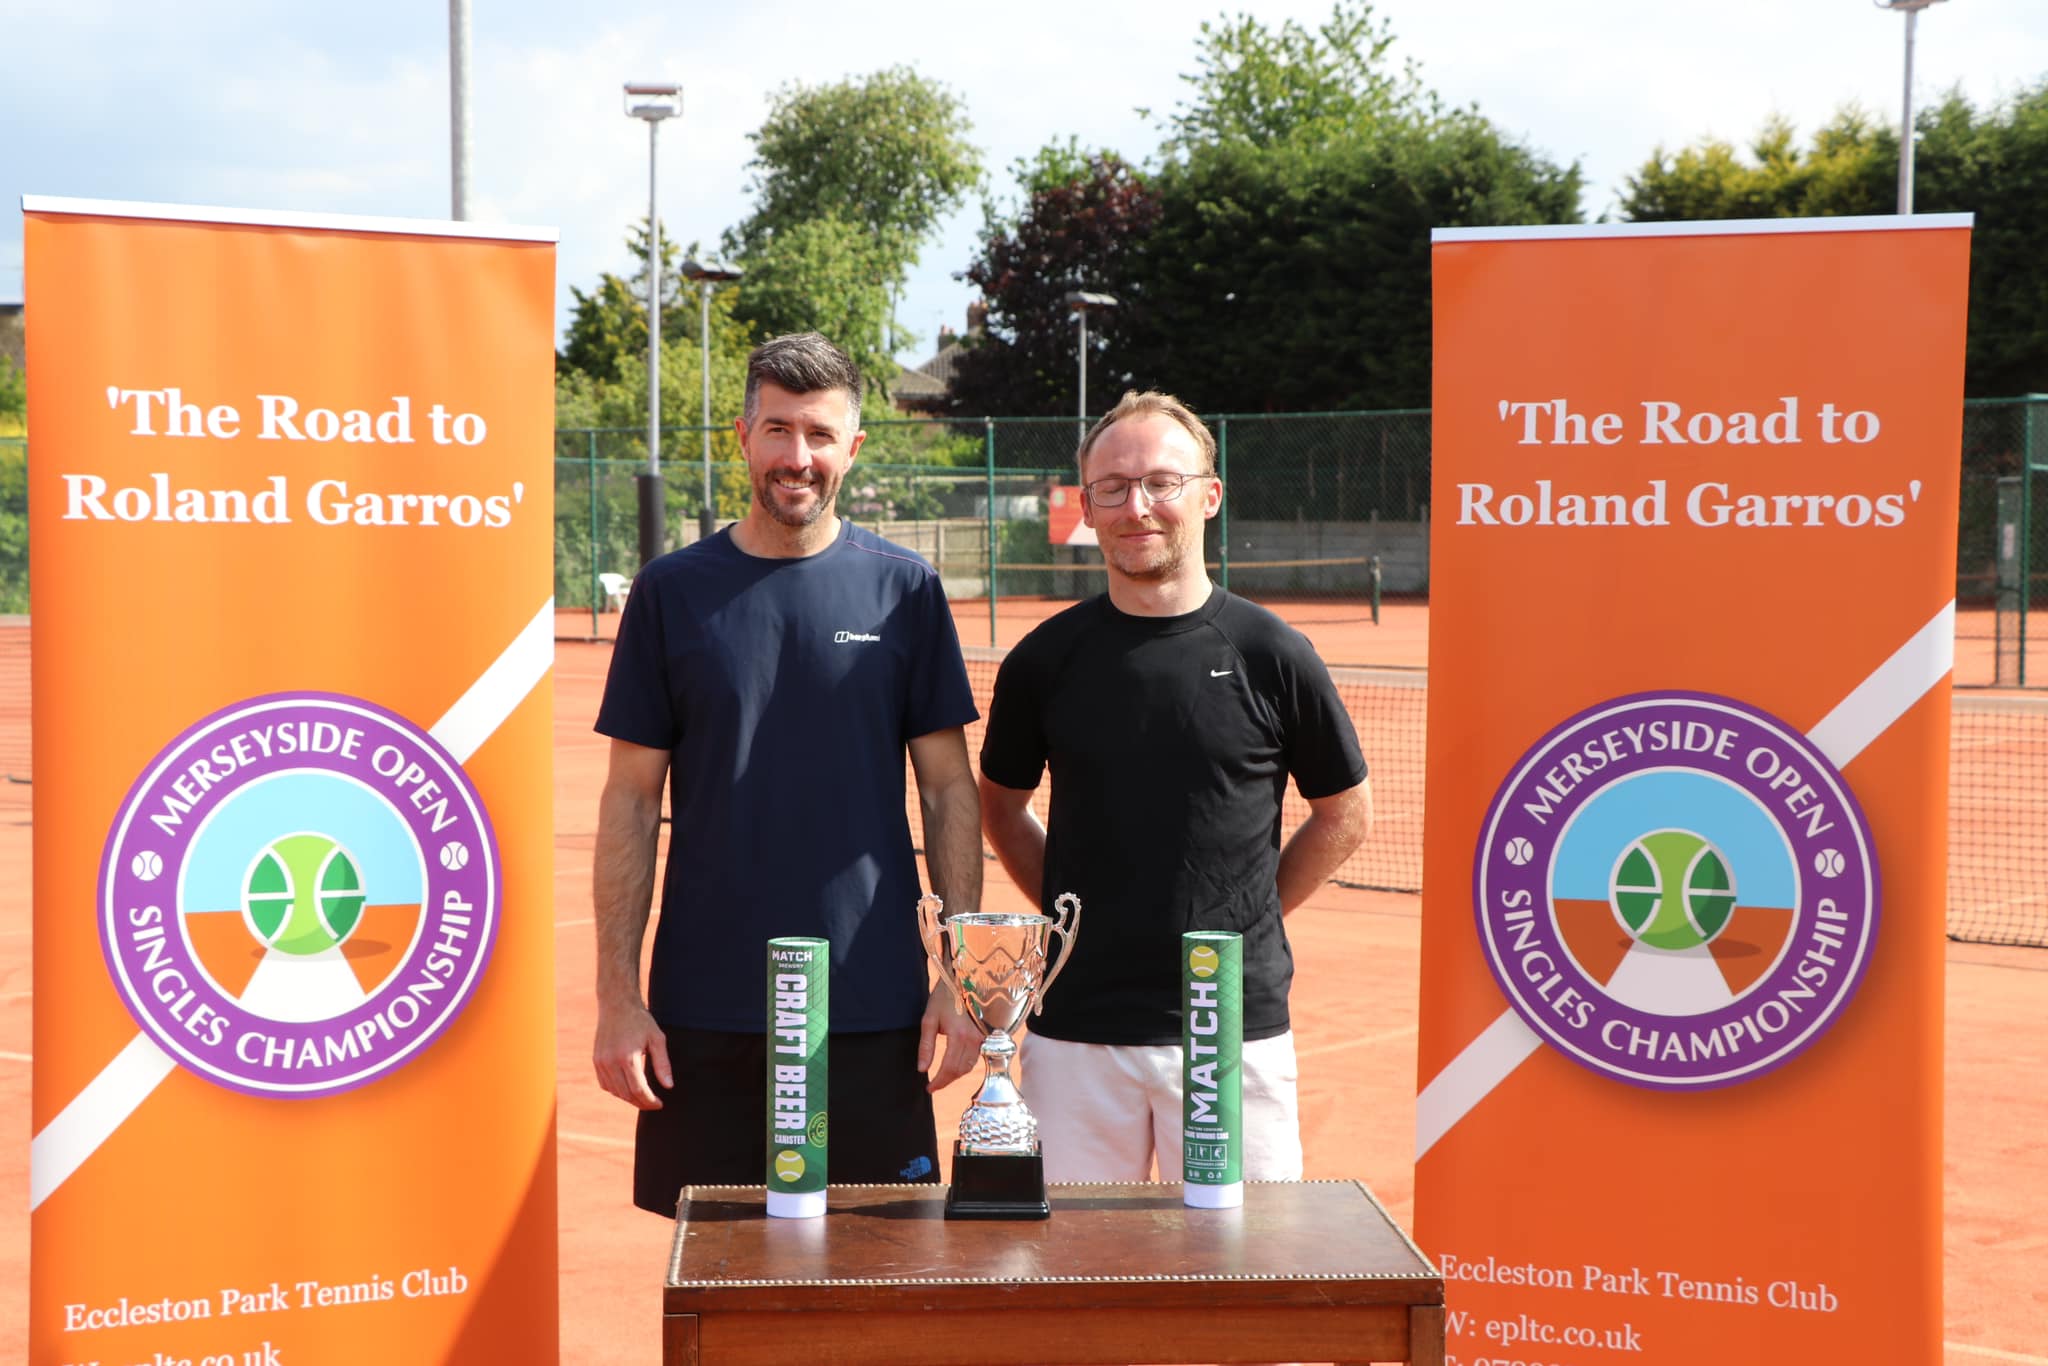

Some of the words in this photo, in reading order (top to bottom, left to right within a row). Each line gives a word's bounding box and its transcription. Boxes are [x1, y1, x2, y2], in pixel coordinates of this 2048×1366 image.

[107, 386, 240, 439] 'The
[257, 395, 415, 443] Road
[428, 403, 487, 446] to
[1498, 398, 1623, 445] 'The
[1640, 396, 1802, 444] Road
[1817, 402, 1881, 444] to
[62, 473, 292, 525] Roland
[306, 479, 524, 528] Garros'
[1456, 480, 1671, 526] Roland
[1686, 479, 1922, 528] Garros'
[150, 721, 366, 837] MERSEYSIDE
[371, 744, 458, 833] OPEN
[1523, 720, 1739, 825] MERSEYSIDE
[1746, 746, 1834, 838] OPEN
[129, 905, 230, 1046] SINGLES
[236, 890, 473, 1070] CHAMPIONSHIP
[772, 950, 812, 962] MATCH
[1502, 889, 1596, 1029] SINGLES
[1601, 897, 1849, 1062] CHAMPIONSHIP
[775, 973, 807, 1057] CRAFT
[1190, 982, 1218, 1123] MATCH
[775, 1065, 807, 1130] BEER
[774, 1134, 806, 1145] CANISTER
[64, 1298, 211, 1331] Eccleston
[220, 1283, 289, 1316] Park
[296, 1274, 394, 1308] Tennis
[402, 1267, 468, 1298] Club
[1440, 1254, 1573, 1289] Eccleston
[1584, 1265, 1651, 1295] Park
[1656, 1271, 1759, 1305] Tennis
[1767, 1281, 1838, 1312] Club
[1485, 1314, 1643, 1351] epltc.co.uk
